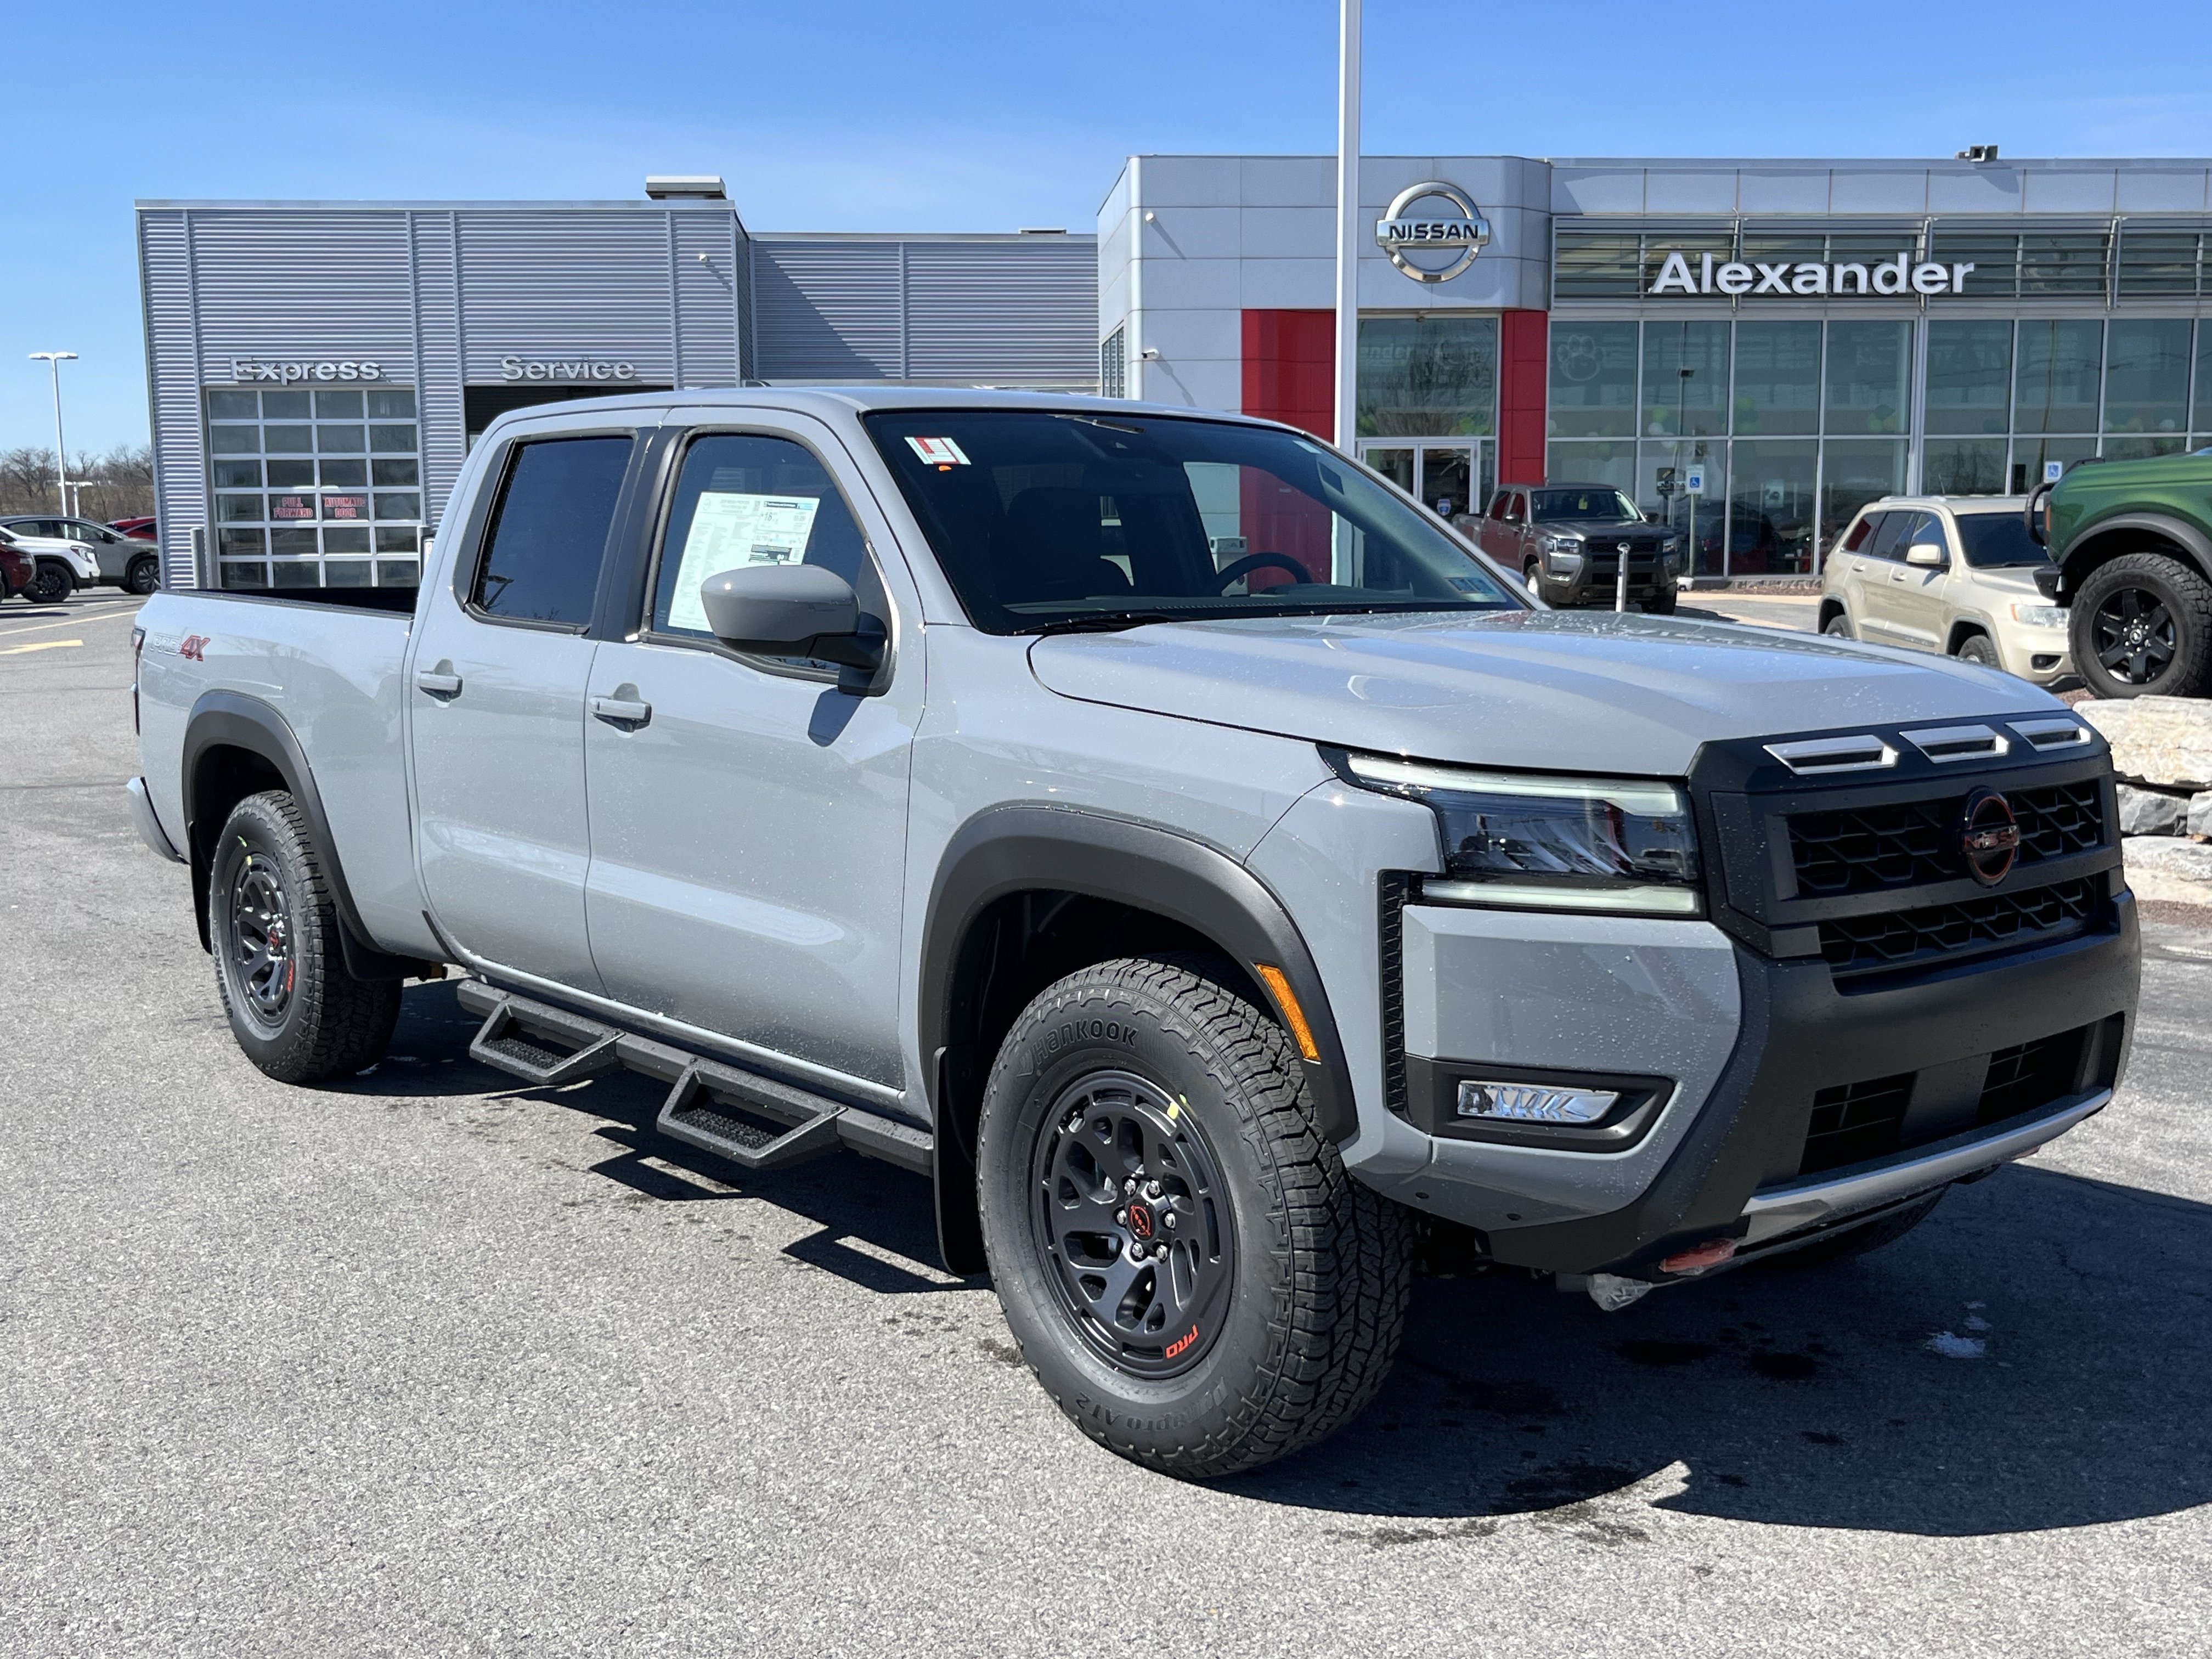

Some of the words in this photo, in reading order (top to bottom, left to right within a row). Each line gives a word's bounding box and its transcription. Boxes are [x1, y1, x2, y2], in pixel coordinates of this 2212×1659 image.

[1389, 223, 1479, 239] NISSAN
[1651, 251, 1975, 295] Alexander
[230, 356, 380, 386] Express
[500, 355, 635, 380] Service
[282, 496, 304, 507] PULL
[324, 496, 366, 507] AUTOMATIC
[274, 507, 313, 518] FORWARD
[335, 507, 357, 518] DOOR
[1165, 1324, 1199, 1359] PRO
